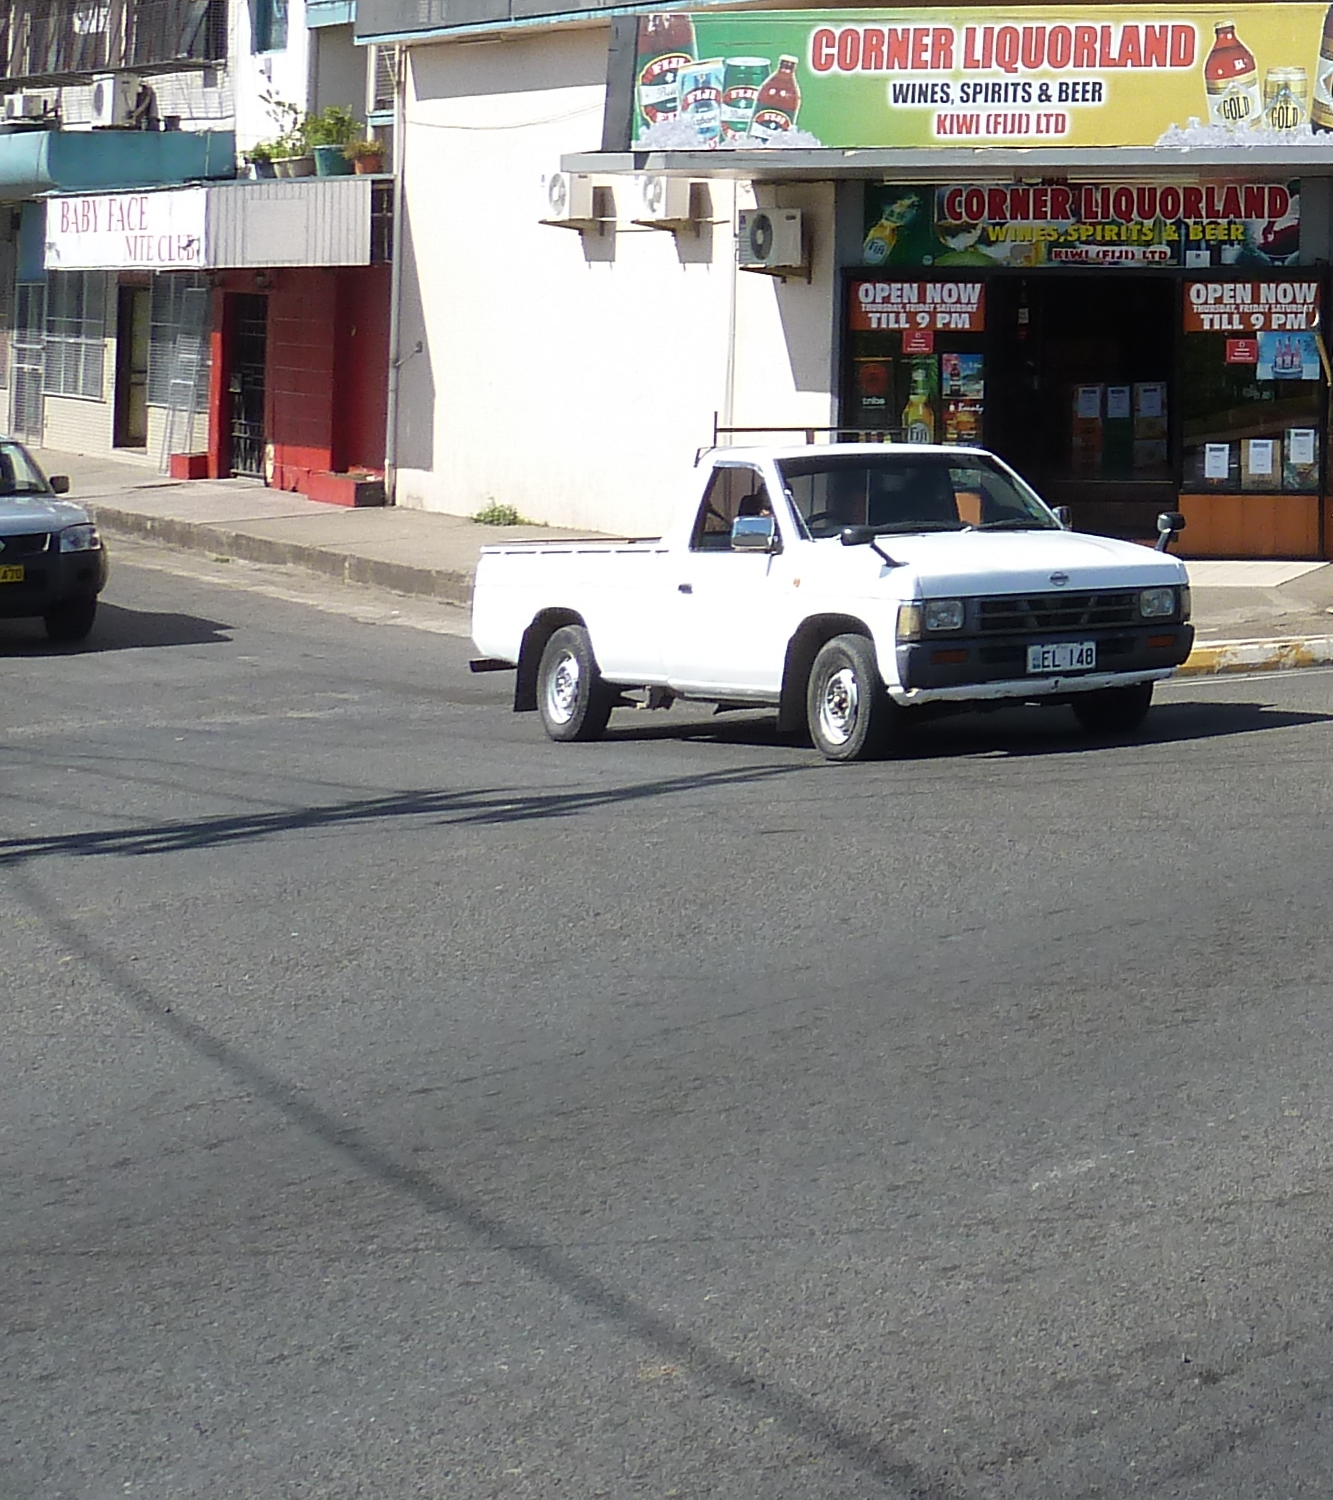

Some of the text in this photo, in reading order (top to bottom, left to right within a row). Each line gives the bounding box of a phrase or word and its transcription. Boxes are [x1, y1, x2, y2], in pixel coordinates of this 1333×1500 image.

[811, 24, 1196, 74] CORNER LIQUORLAND
[687, 88, 717, 104] FIJI
[892, 81, 1103, 105] WINES, SPIRITS & BEER
[1223, 96, 1250, 120] GOLD
[1271, 106, 1298, 129] GOLD
[936, 113, 1067, 135] KIWI (FIJI) LTD
[60, 196, 149, 233] BABY FACE
[946, 185, 1290, 224] CORNER LIQUORLAND
[1164, 224, 1180, 241] &
[1189, 224, 1247, 241] BEER
[124, 235, 154, 261] NITE
[1053, 249, 1089, 261] KIWI
[1142, 249, 1168, 261] LTD
[858, 283, 982, 303] OPEN NOW
[1190, 283, 1318, 304] OPEN NOW
[906, 304, 935, 312] FRIDAY
[1239, 304, 1269, 312] FRIDAY
[868, 312, 971, 328] TILL 9 PM
[1200, 313, 1307, 329] TILL 9 PM
[1041, 650, 1061, 669] EL
[1070, 647, 1094, 667] 148
